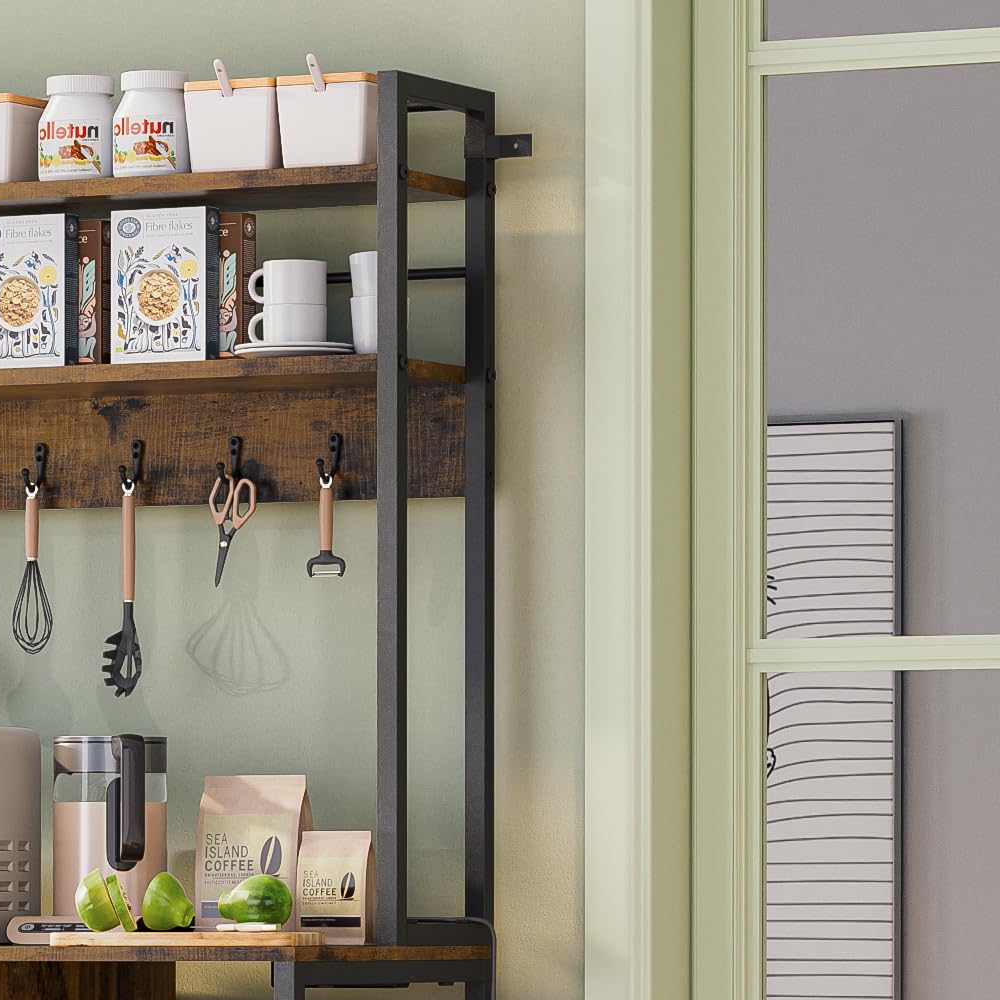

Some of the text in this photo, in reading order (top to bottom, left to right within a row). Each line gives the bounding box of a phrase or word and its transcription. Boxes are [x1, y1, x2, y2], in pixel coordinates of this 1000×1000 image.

[145, 219, 193, 232] Fibre flakes
[5, 227, 53, 239] Fibre flakes
[205, 832, 228, 846] SEA
[204, 845, 249, 859] ISLAND
[204, 859, 254, 872] COFFEE
[303, 869, 319, 879] SEA
[302, 878, 333, 888] ISLAND
[302, 887, 337, 896] COFFEE
